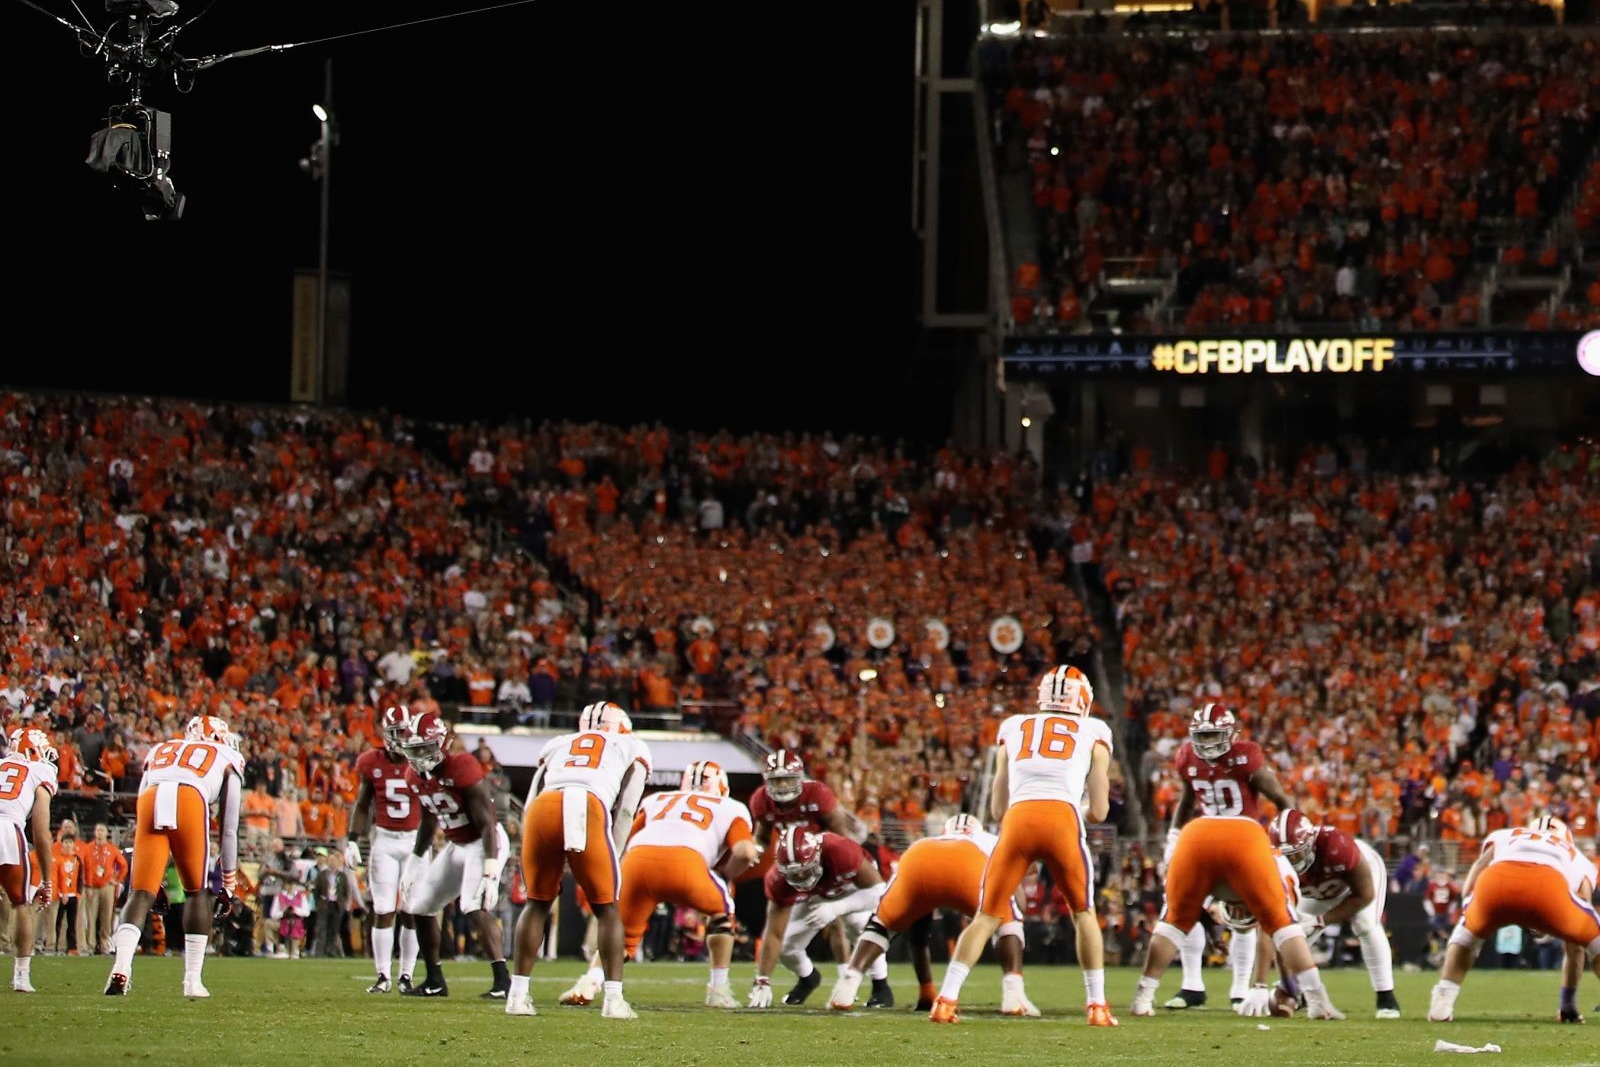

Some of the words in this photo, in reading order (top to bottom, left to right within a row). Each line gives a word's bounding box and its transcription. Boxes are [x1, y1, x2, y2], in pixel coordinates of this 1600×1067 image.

[1152, 339, 1395, 374] #CFBPLAYOFF
[564, 733, 606, 769] 9
[1015, 716, 1080, 761] 16
[385, 779, 410, 818] 5
[652, 792, 721, 831] 75
